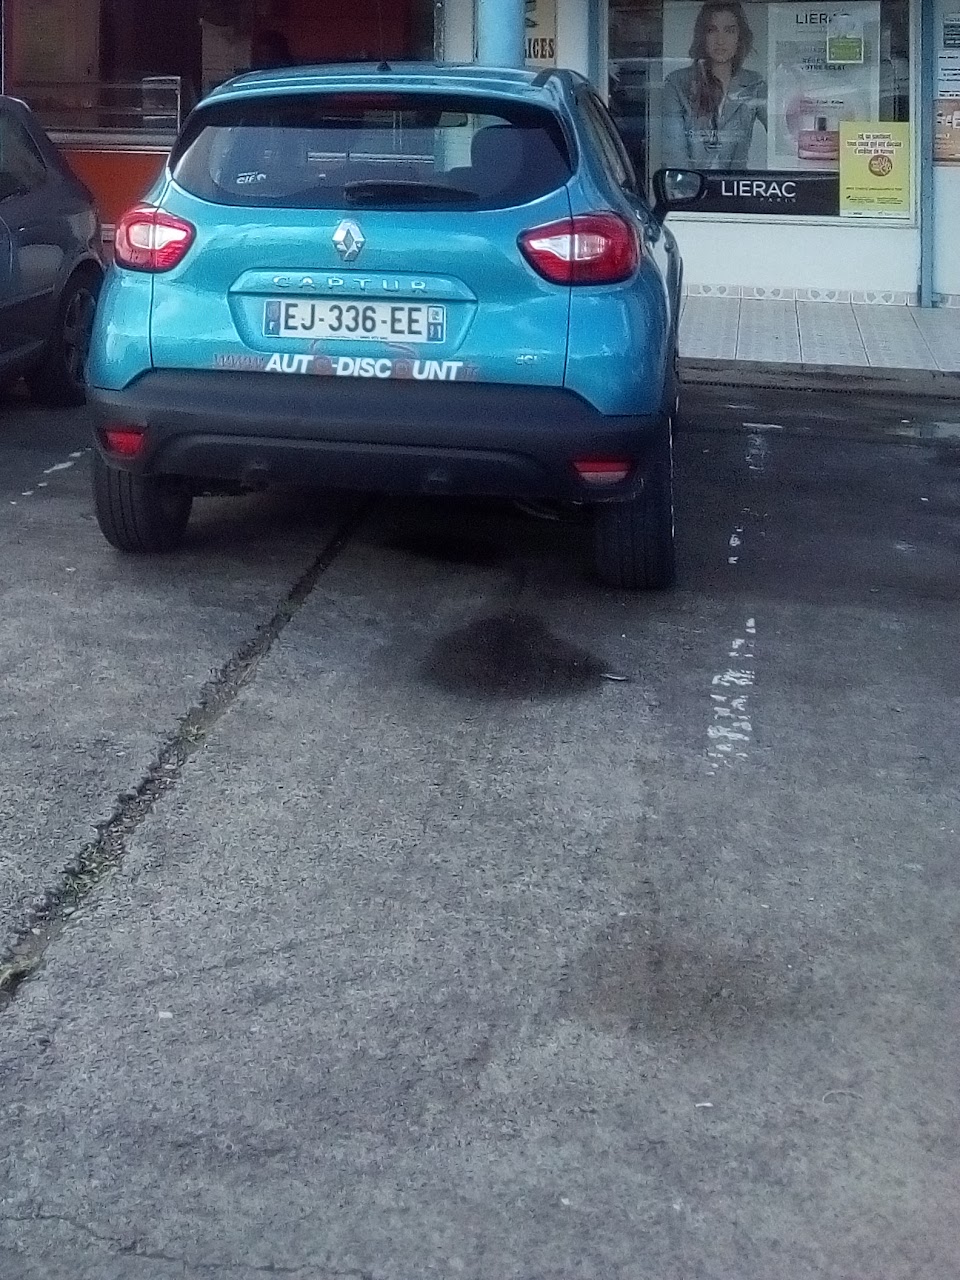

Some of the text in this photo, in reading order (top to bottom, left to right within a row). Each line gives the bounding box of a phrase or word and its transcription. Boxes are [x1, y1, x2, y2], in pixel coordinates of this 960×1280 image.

[795, 13, 850, 24] LIER
[525, 38, 555, 59] ICES
[721, 180, 797, 198] LIERAC
[272, 275, 428, 293] CAPTUR
[283, 302, 423, 336] EJ-336-EE
